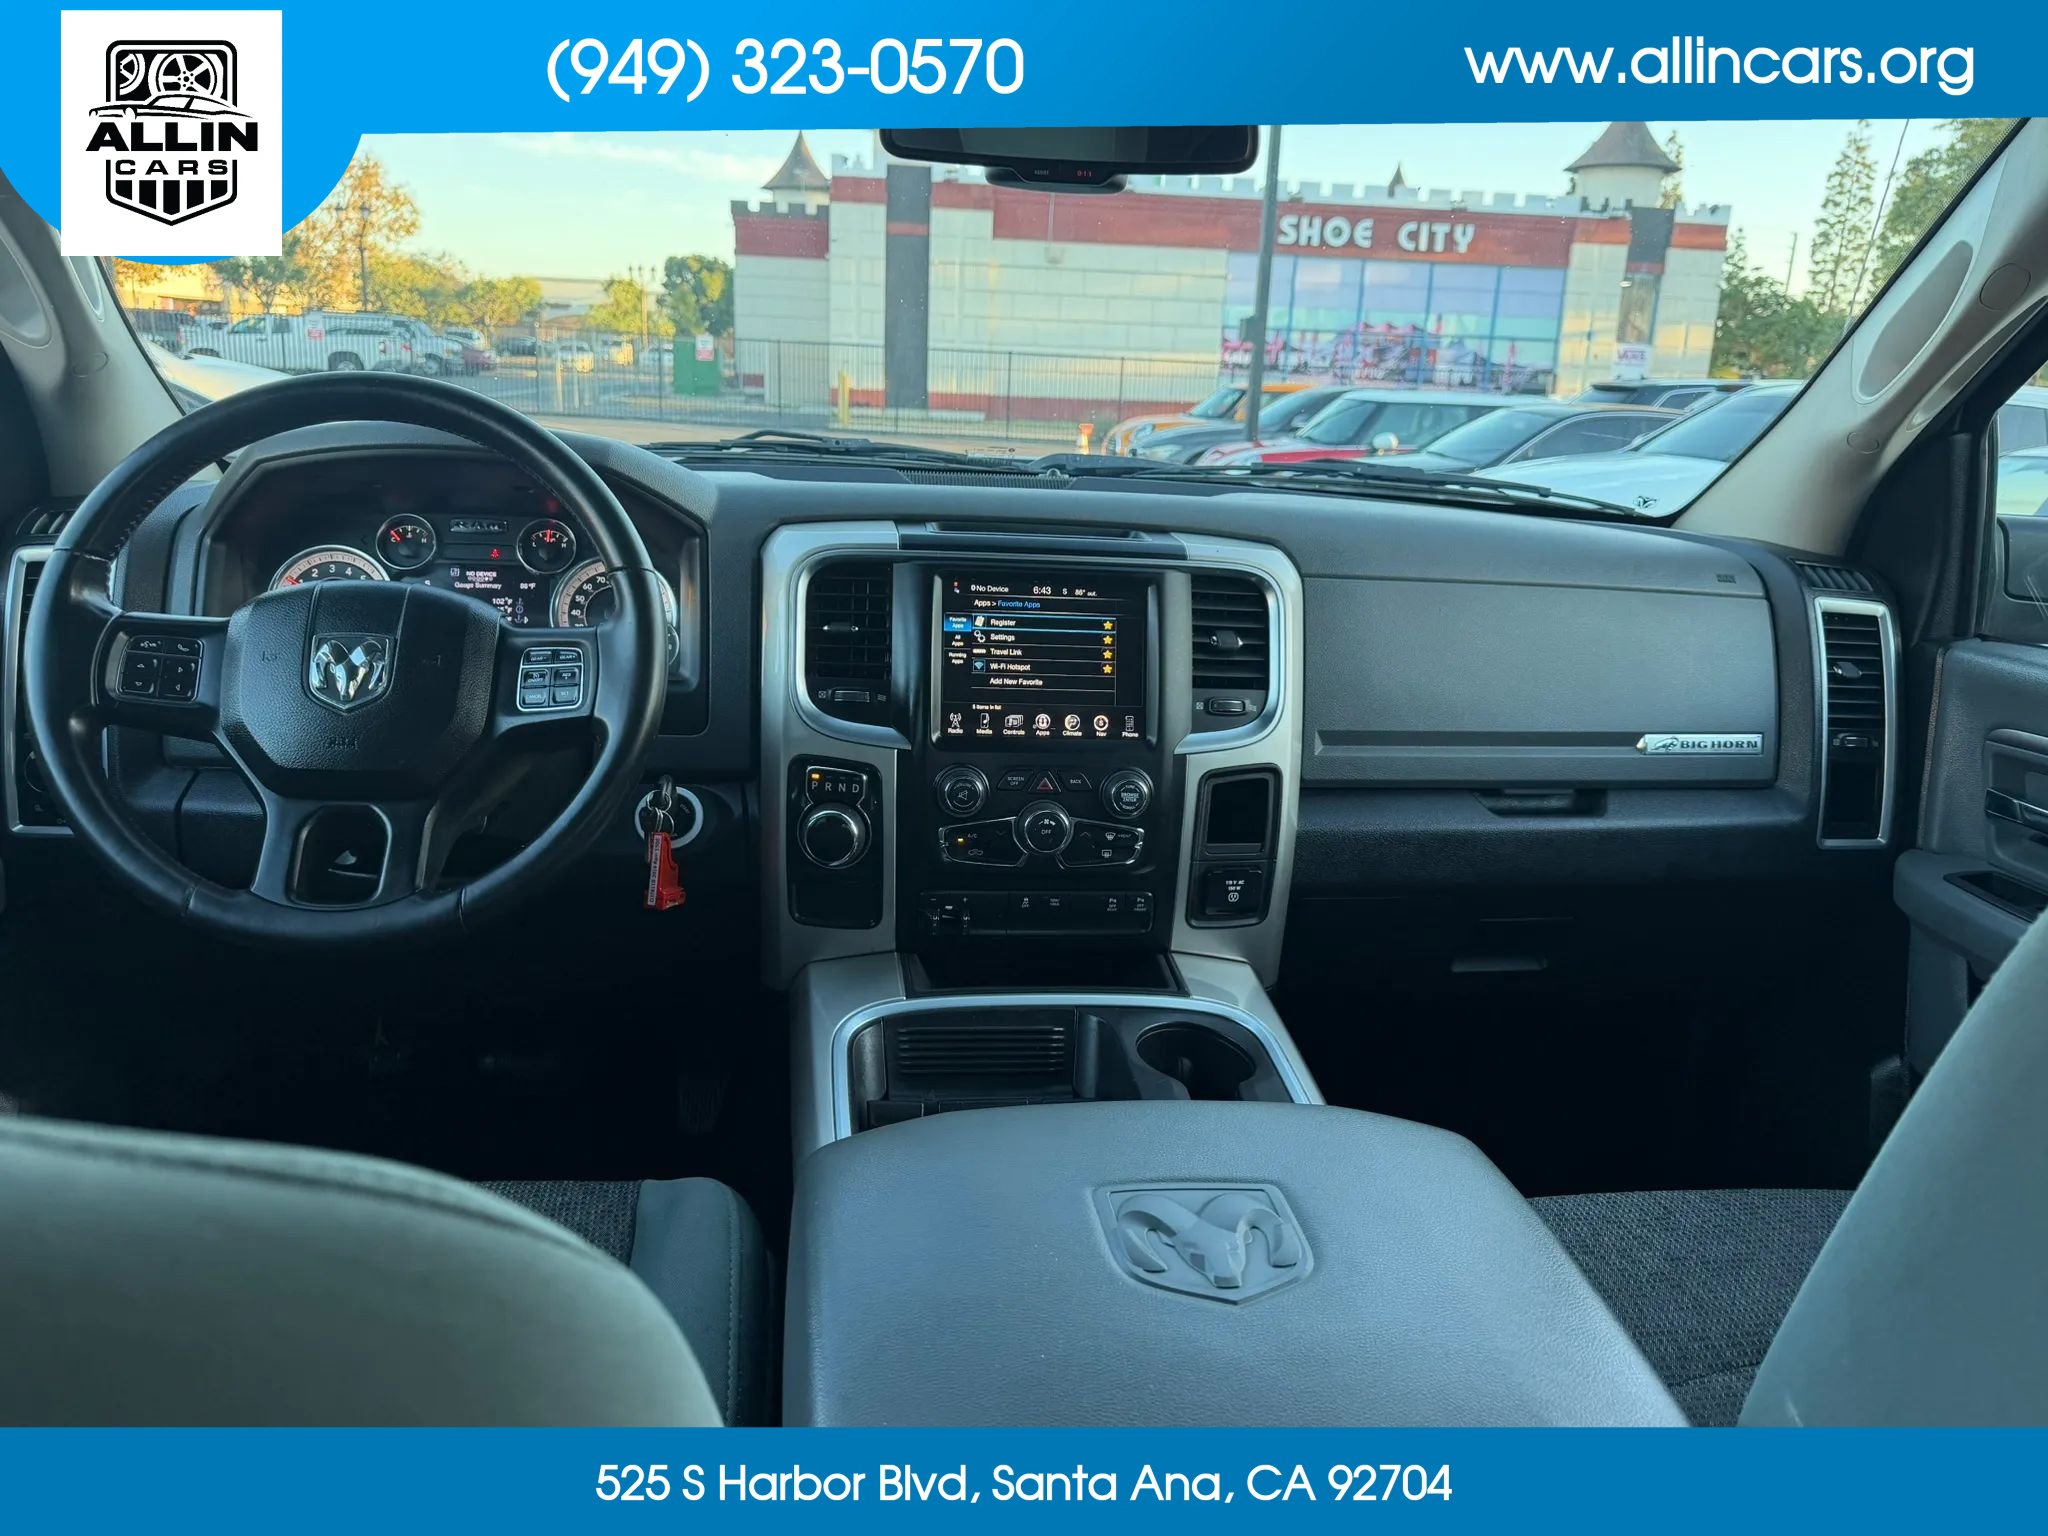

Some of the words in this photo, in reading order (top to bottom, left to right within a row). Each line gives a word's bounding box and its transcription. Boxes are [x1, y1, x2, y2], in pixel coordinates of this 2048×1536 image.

[1277, 214, 1374, 249] SHOE
[1397, 221, 1476, 254] CITY
[311, 568, 319, 577] 2
[329, 564, 336, 573] 3
[345, 567, 352, 576] 4
[596, 576, 606, 584] 70
[1033, 586, 1052, 595] 6:43
[974, 600, 991, 608] Apps
[998, 600, 1023, 608] Favorite
[1024, 601, 1041, 609] Apps
[990, 619, 1016, 628] Register
[990, 633, 1016, 642] Settings
[990, 648, 1009, 656] Travel
[1010, 648, 1023, 656] Link
[1007, 663, 1031, 671] Hotspot
[1004, 678, 1018, 686] New
[1018, 678, 1043, 686] Favorite
[1680, 740, 1708, 749] BIG
[1711, 740, 1758, 749] HORN
[811, 781, 818, 790] P
[824, 782, 832, 791] R
[838, 783, 846, 792] N
[852, 784, 860, 793] D
